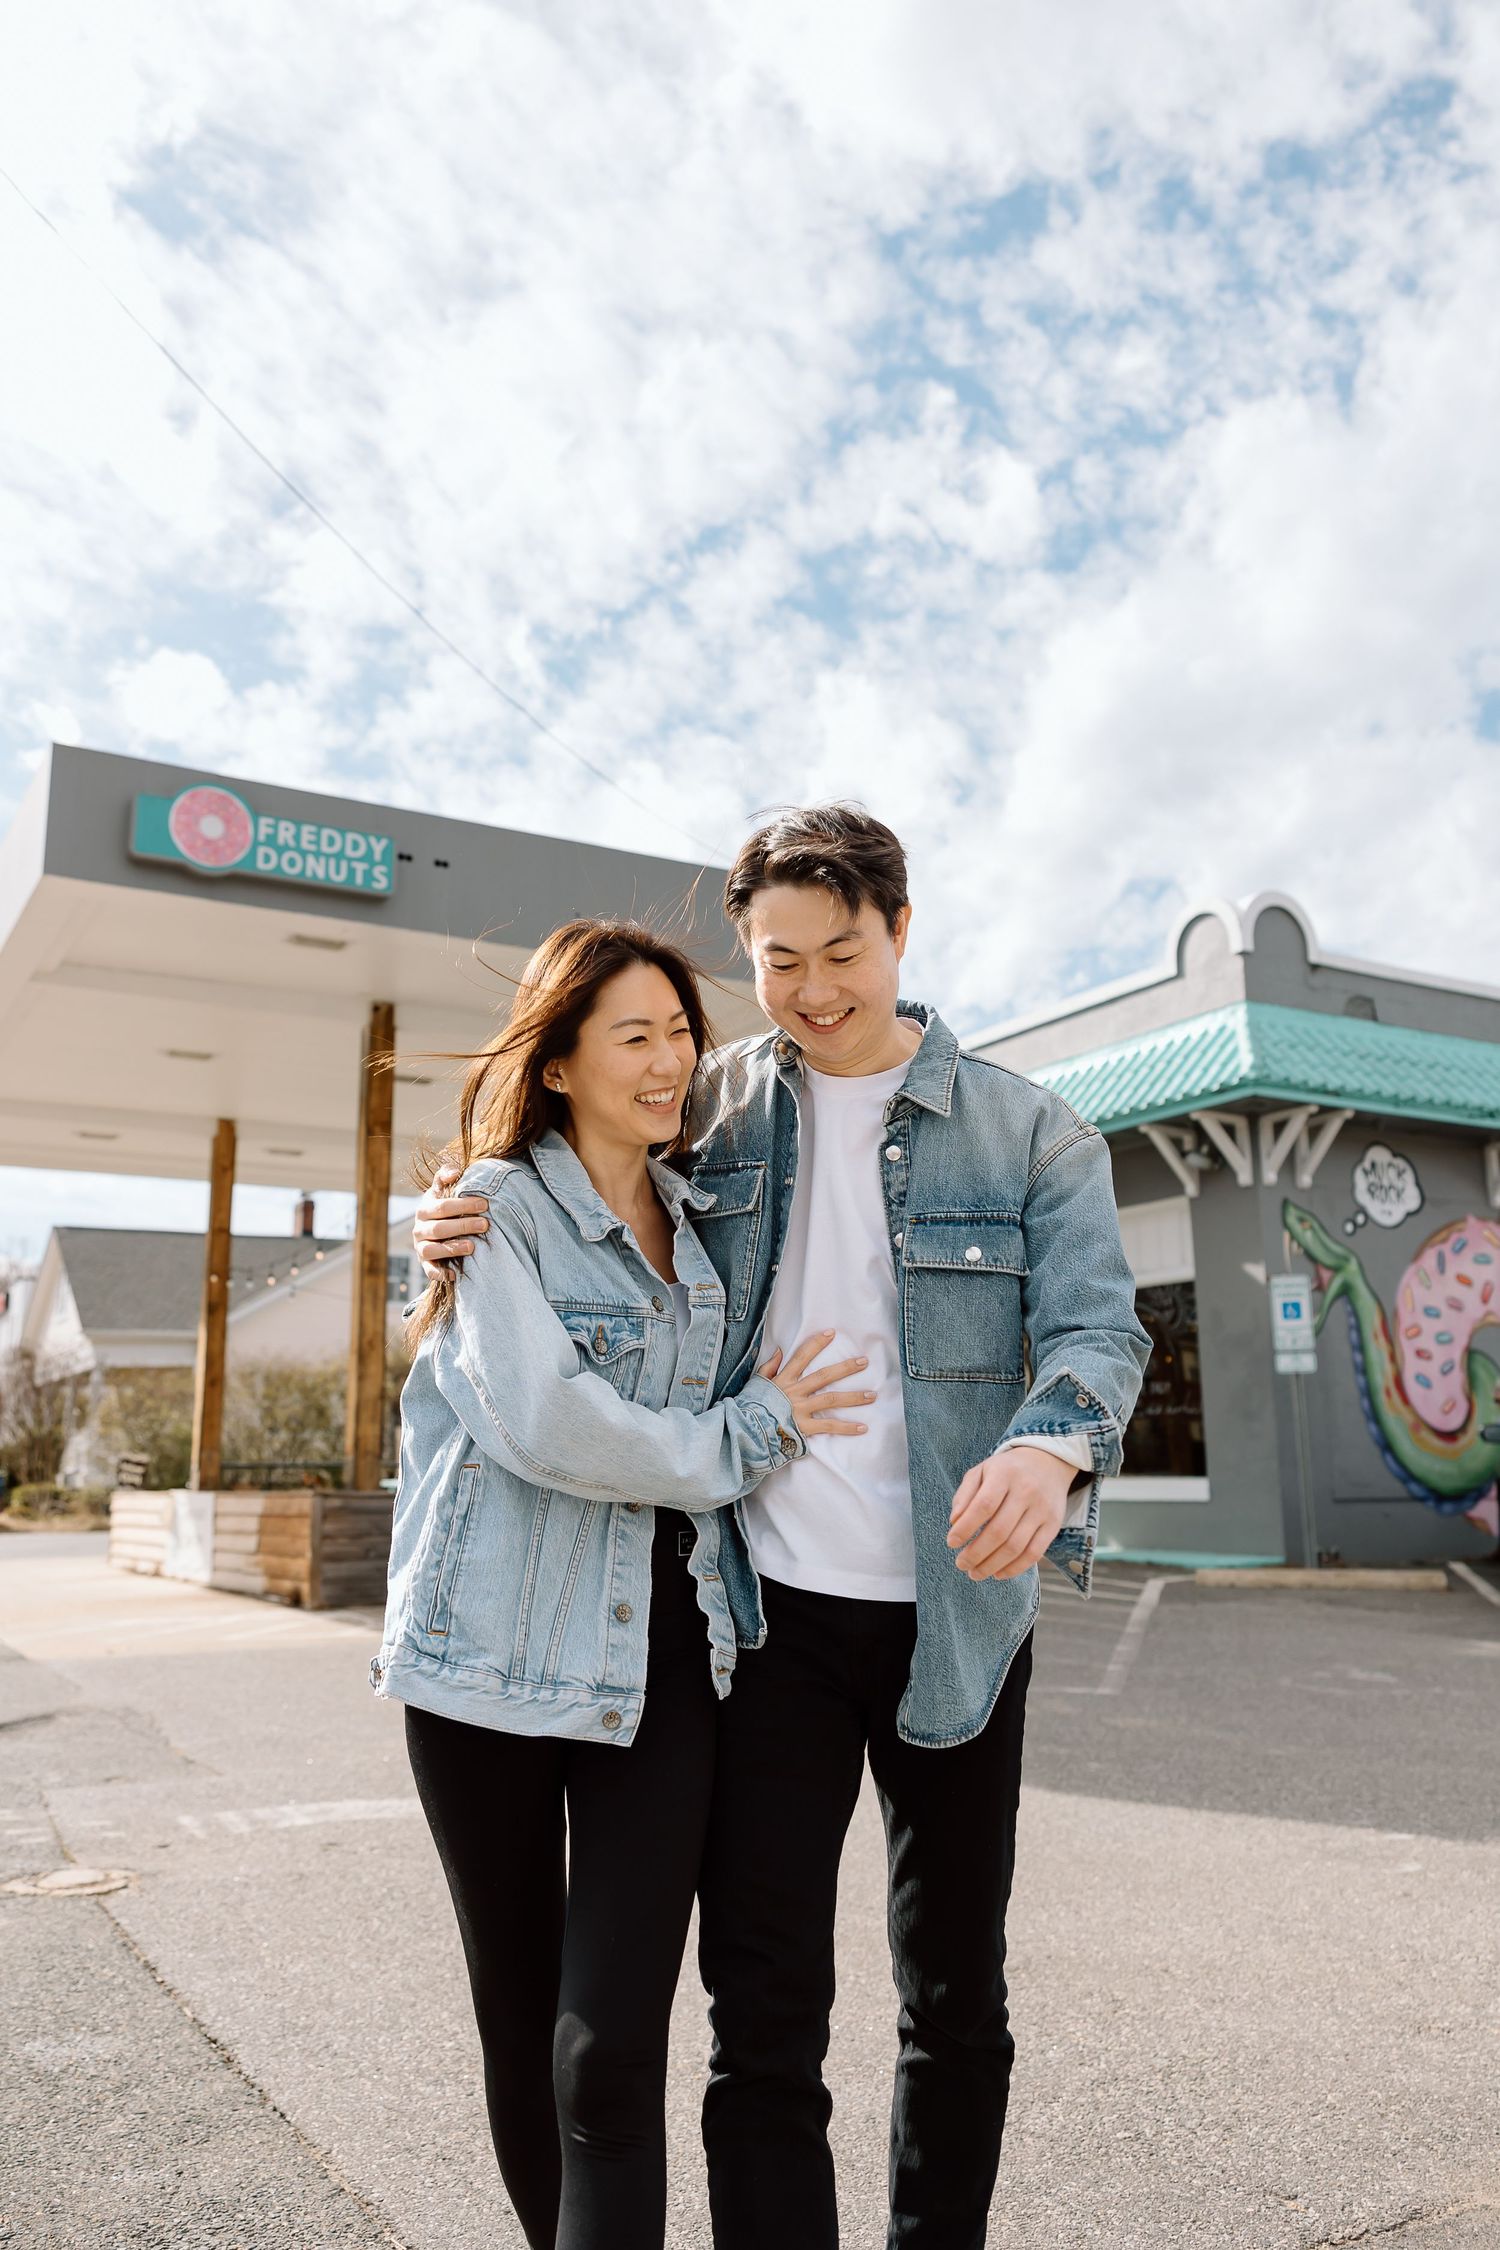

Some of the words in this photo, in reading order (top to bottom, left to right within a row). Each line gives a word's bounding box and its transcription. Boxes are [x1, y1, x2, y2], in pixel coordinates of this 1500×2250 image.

[258, 817, 388, 862] FREDDY
[257, 846, 388, 889] DONUTS
[1367, 1182, 1405, 1205] ROCK
